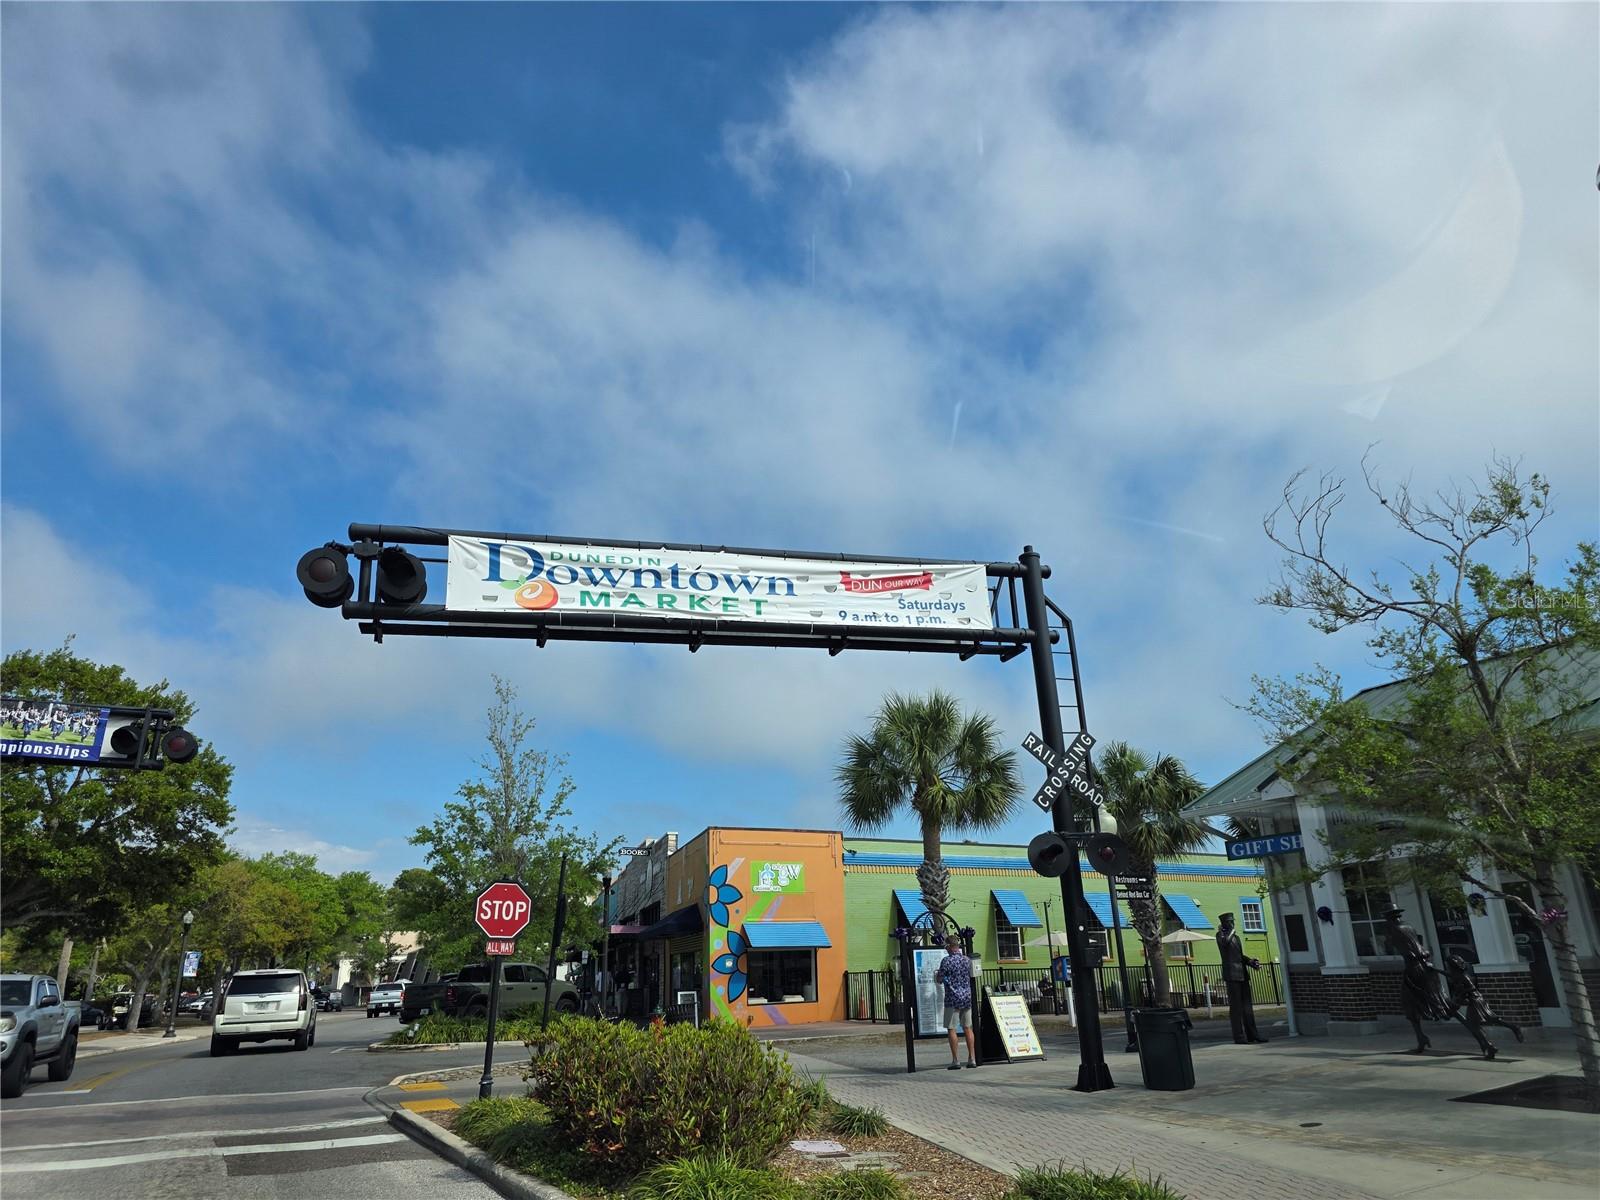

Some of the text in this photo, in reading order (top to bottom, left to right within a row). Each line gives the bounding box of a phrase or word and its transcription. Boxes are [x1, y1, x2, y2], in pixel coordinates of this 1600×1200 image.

[550, 551, 661, 566] DUNEDIN
[480, 541, 798, 596] Downtown
[851, 578, 924, 591] DUN OUR WAY
[579, 590, 768, 616] MARKET
[898, 599, 966, 613] Saturdays
[838, 610, 946, 626] 9 a.m. to 1 p.m.
[1025, 735, 1103, 806] RAIL ROAD
[1038, 734, 1092, 807] CROSSING
[1231, 838, 1274, 857] GIFT
[480, 900, 527, 920] STOP
[487, 942, 513, 953] ALL WAY
